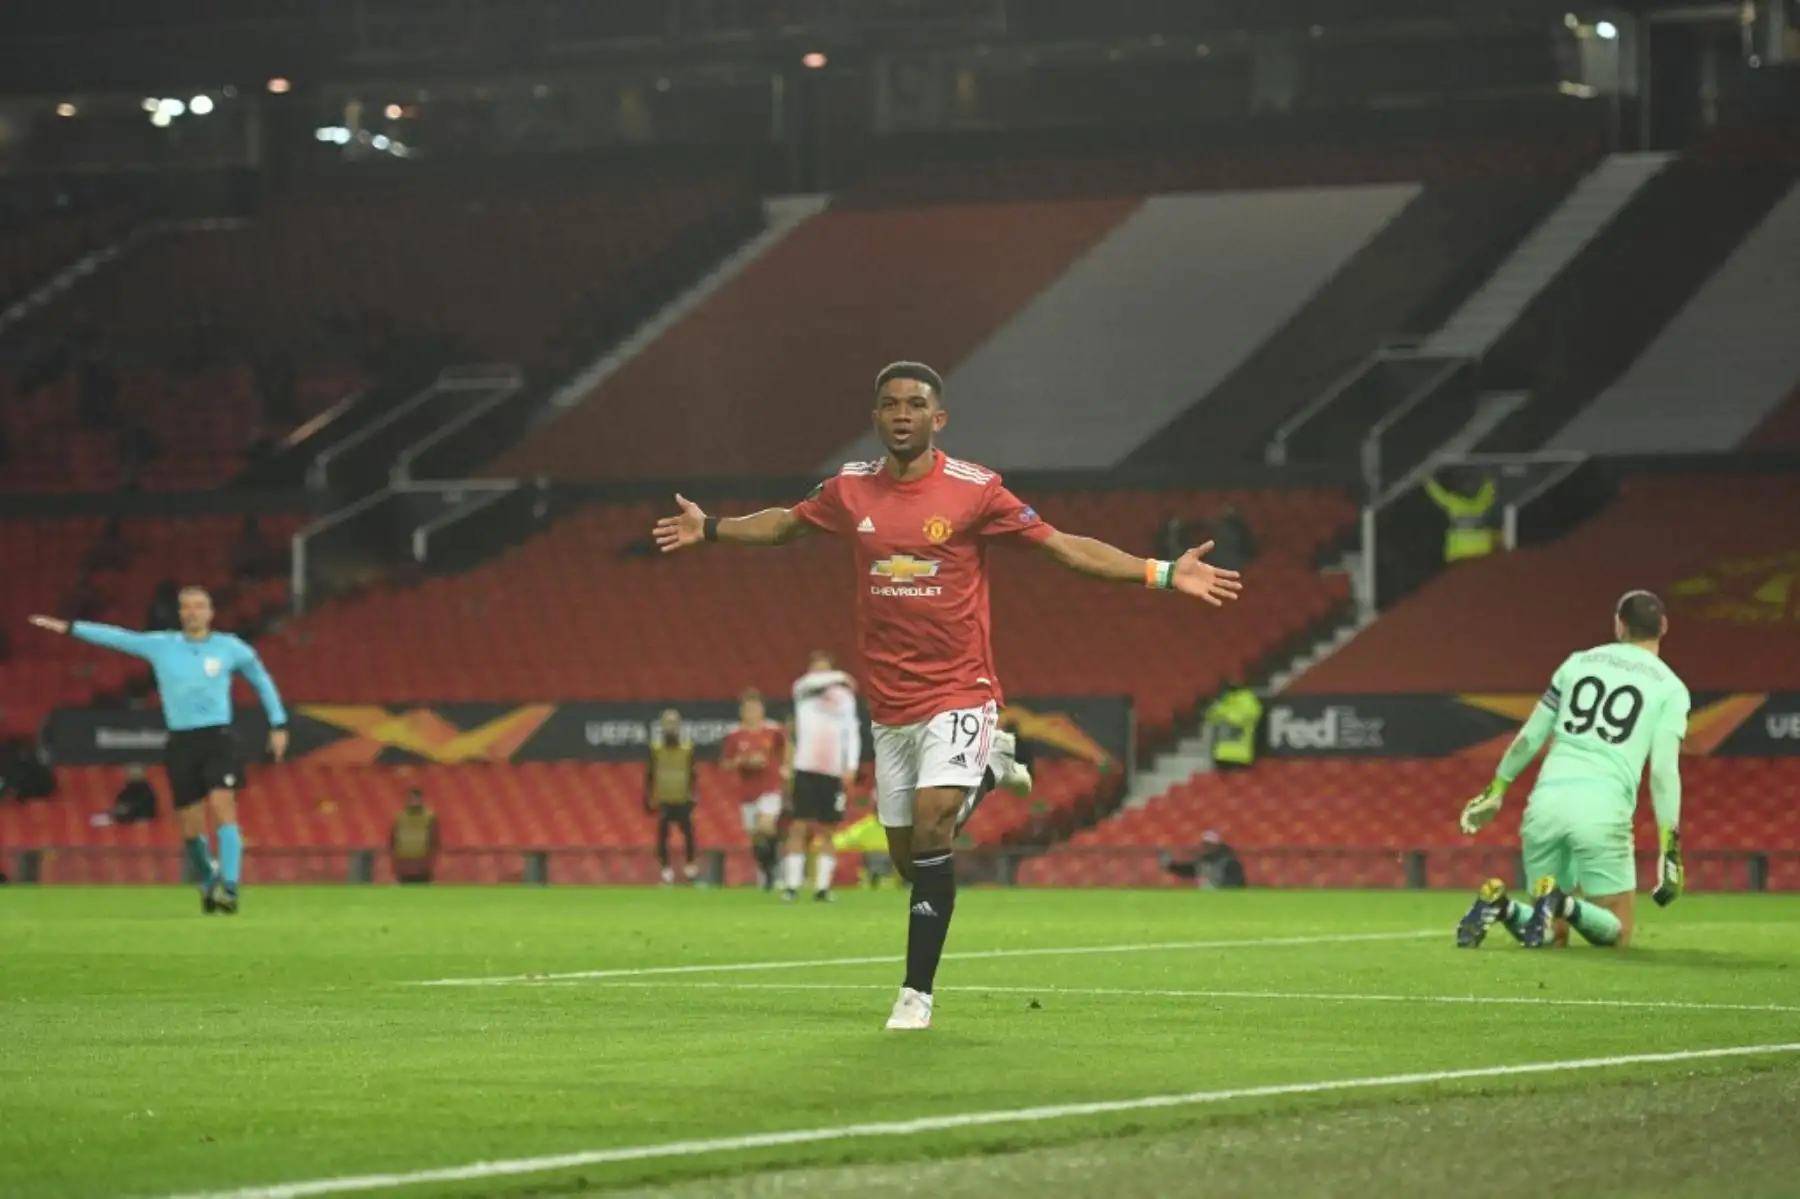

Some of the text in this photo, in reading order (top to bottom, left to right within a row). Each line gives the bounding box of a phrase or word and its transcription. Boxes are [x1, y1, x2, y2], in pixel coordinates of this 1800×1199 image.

[870, 585, 943, 597] CHEVROLET
[949, 711, 980, 748] 19
[1269, 705, 1386, 749] FedEx
[1564, 676, 1644, 745] 99
